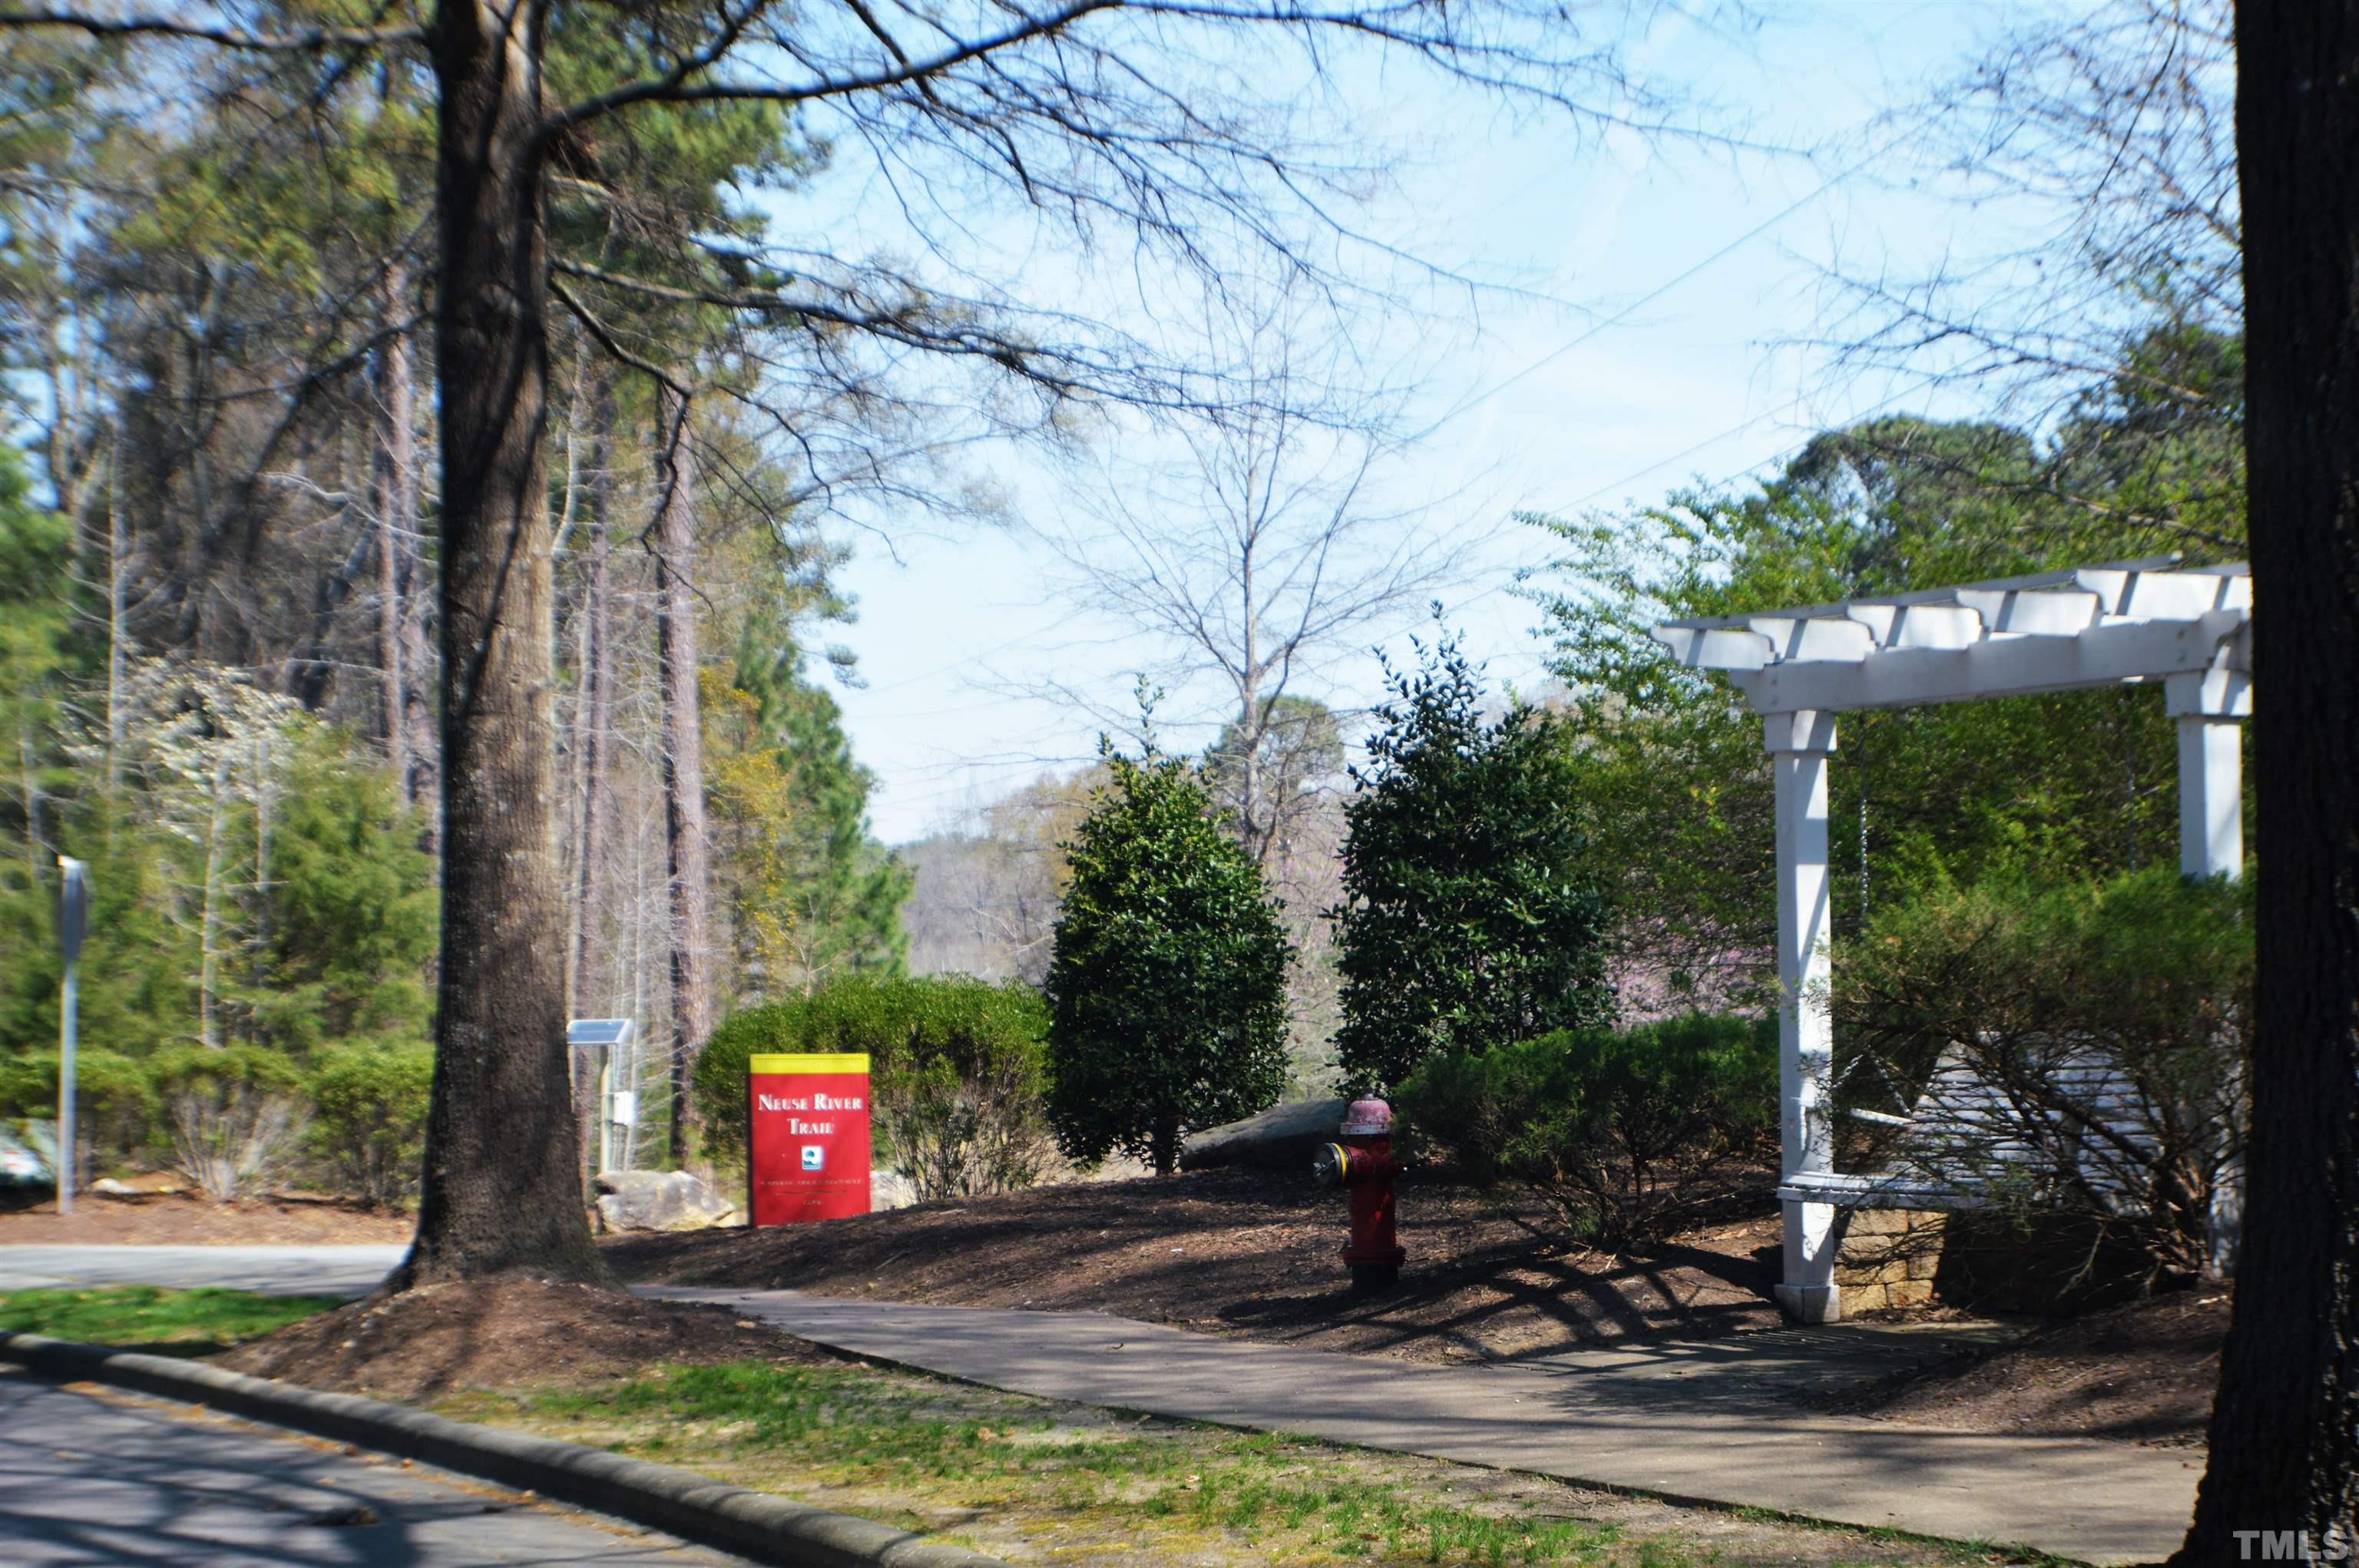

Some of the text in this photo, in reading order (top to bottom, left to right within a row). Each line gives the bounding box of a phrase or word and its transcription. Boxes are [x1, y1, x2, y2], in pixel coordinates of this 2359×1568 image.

[758, 1093, 862, 1111] NEUSE RIVER
[787, 1118, 834, 1135] TRAIL
